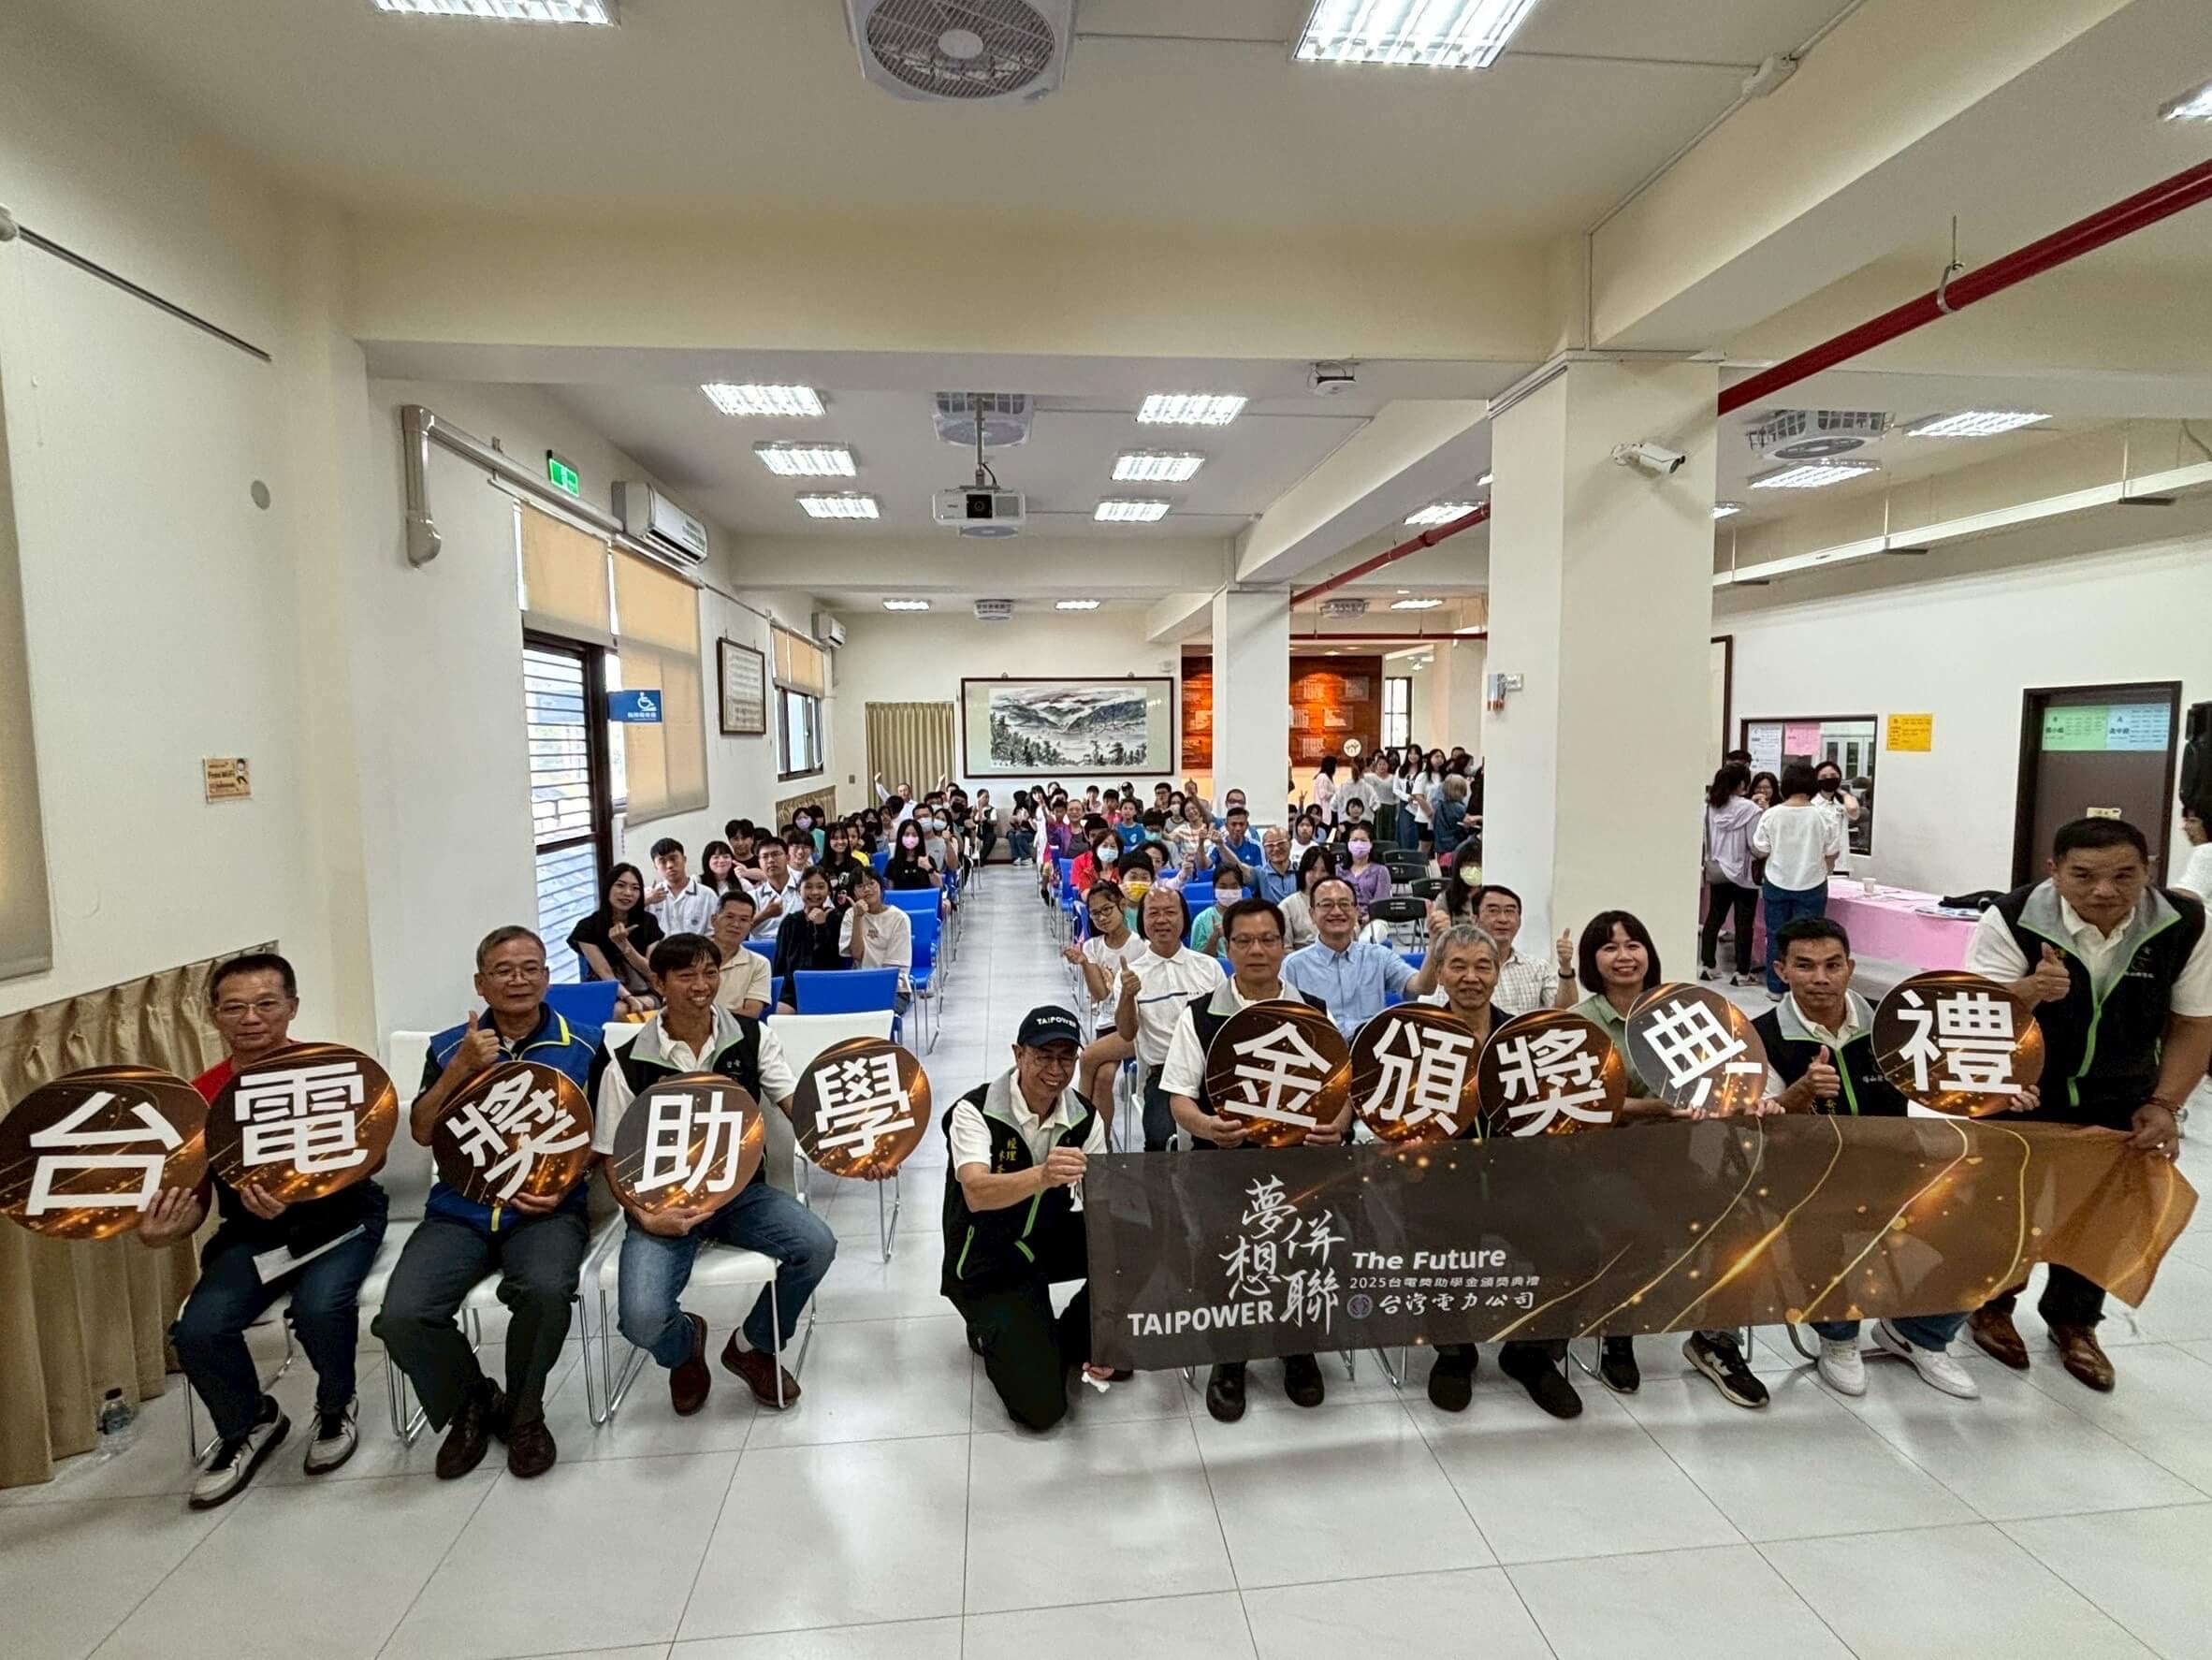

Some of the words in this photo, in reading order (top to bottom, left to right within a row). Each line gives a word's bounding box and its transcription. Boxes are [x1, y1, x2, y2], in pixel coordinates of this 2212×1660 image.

[1225, 1021, 1332, 1129] 金
[1360, 1018, 1474, 1136] 頒
[1496, 1029, 1613, 1138] 獎
[1642, 999, 1762, 1108] 典
[1898, 989, 2022, 1094] 禮
[28, 1091, 182, 1215] 台
[235, 1062, 368, 1173] 電
[446, 1070, 589, 1201] 獎
[634, 1091, 743, 1194] 助
[814, 1053, 915, 1158] 學
[1218, 1174, 1298, 1301] 夢想
[1352, 1251, 1404, 1270] The
[1413, 1249, 1506, 1270] Future
[1128, 1301, 1274, 1336] TAIPOWER
